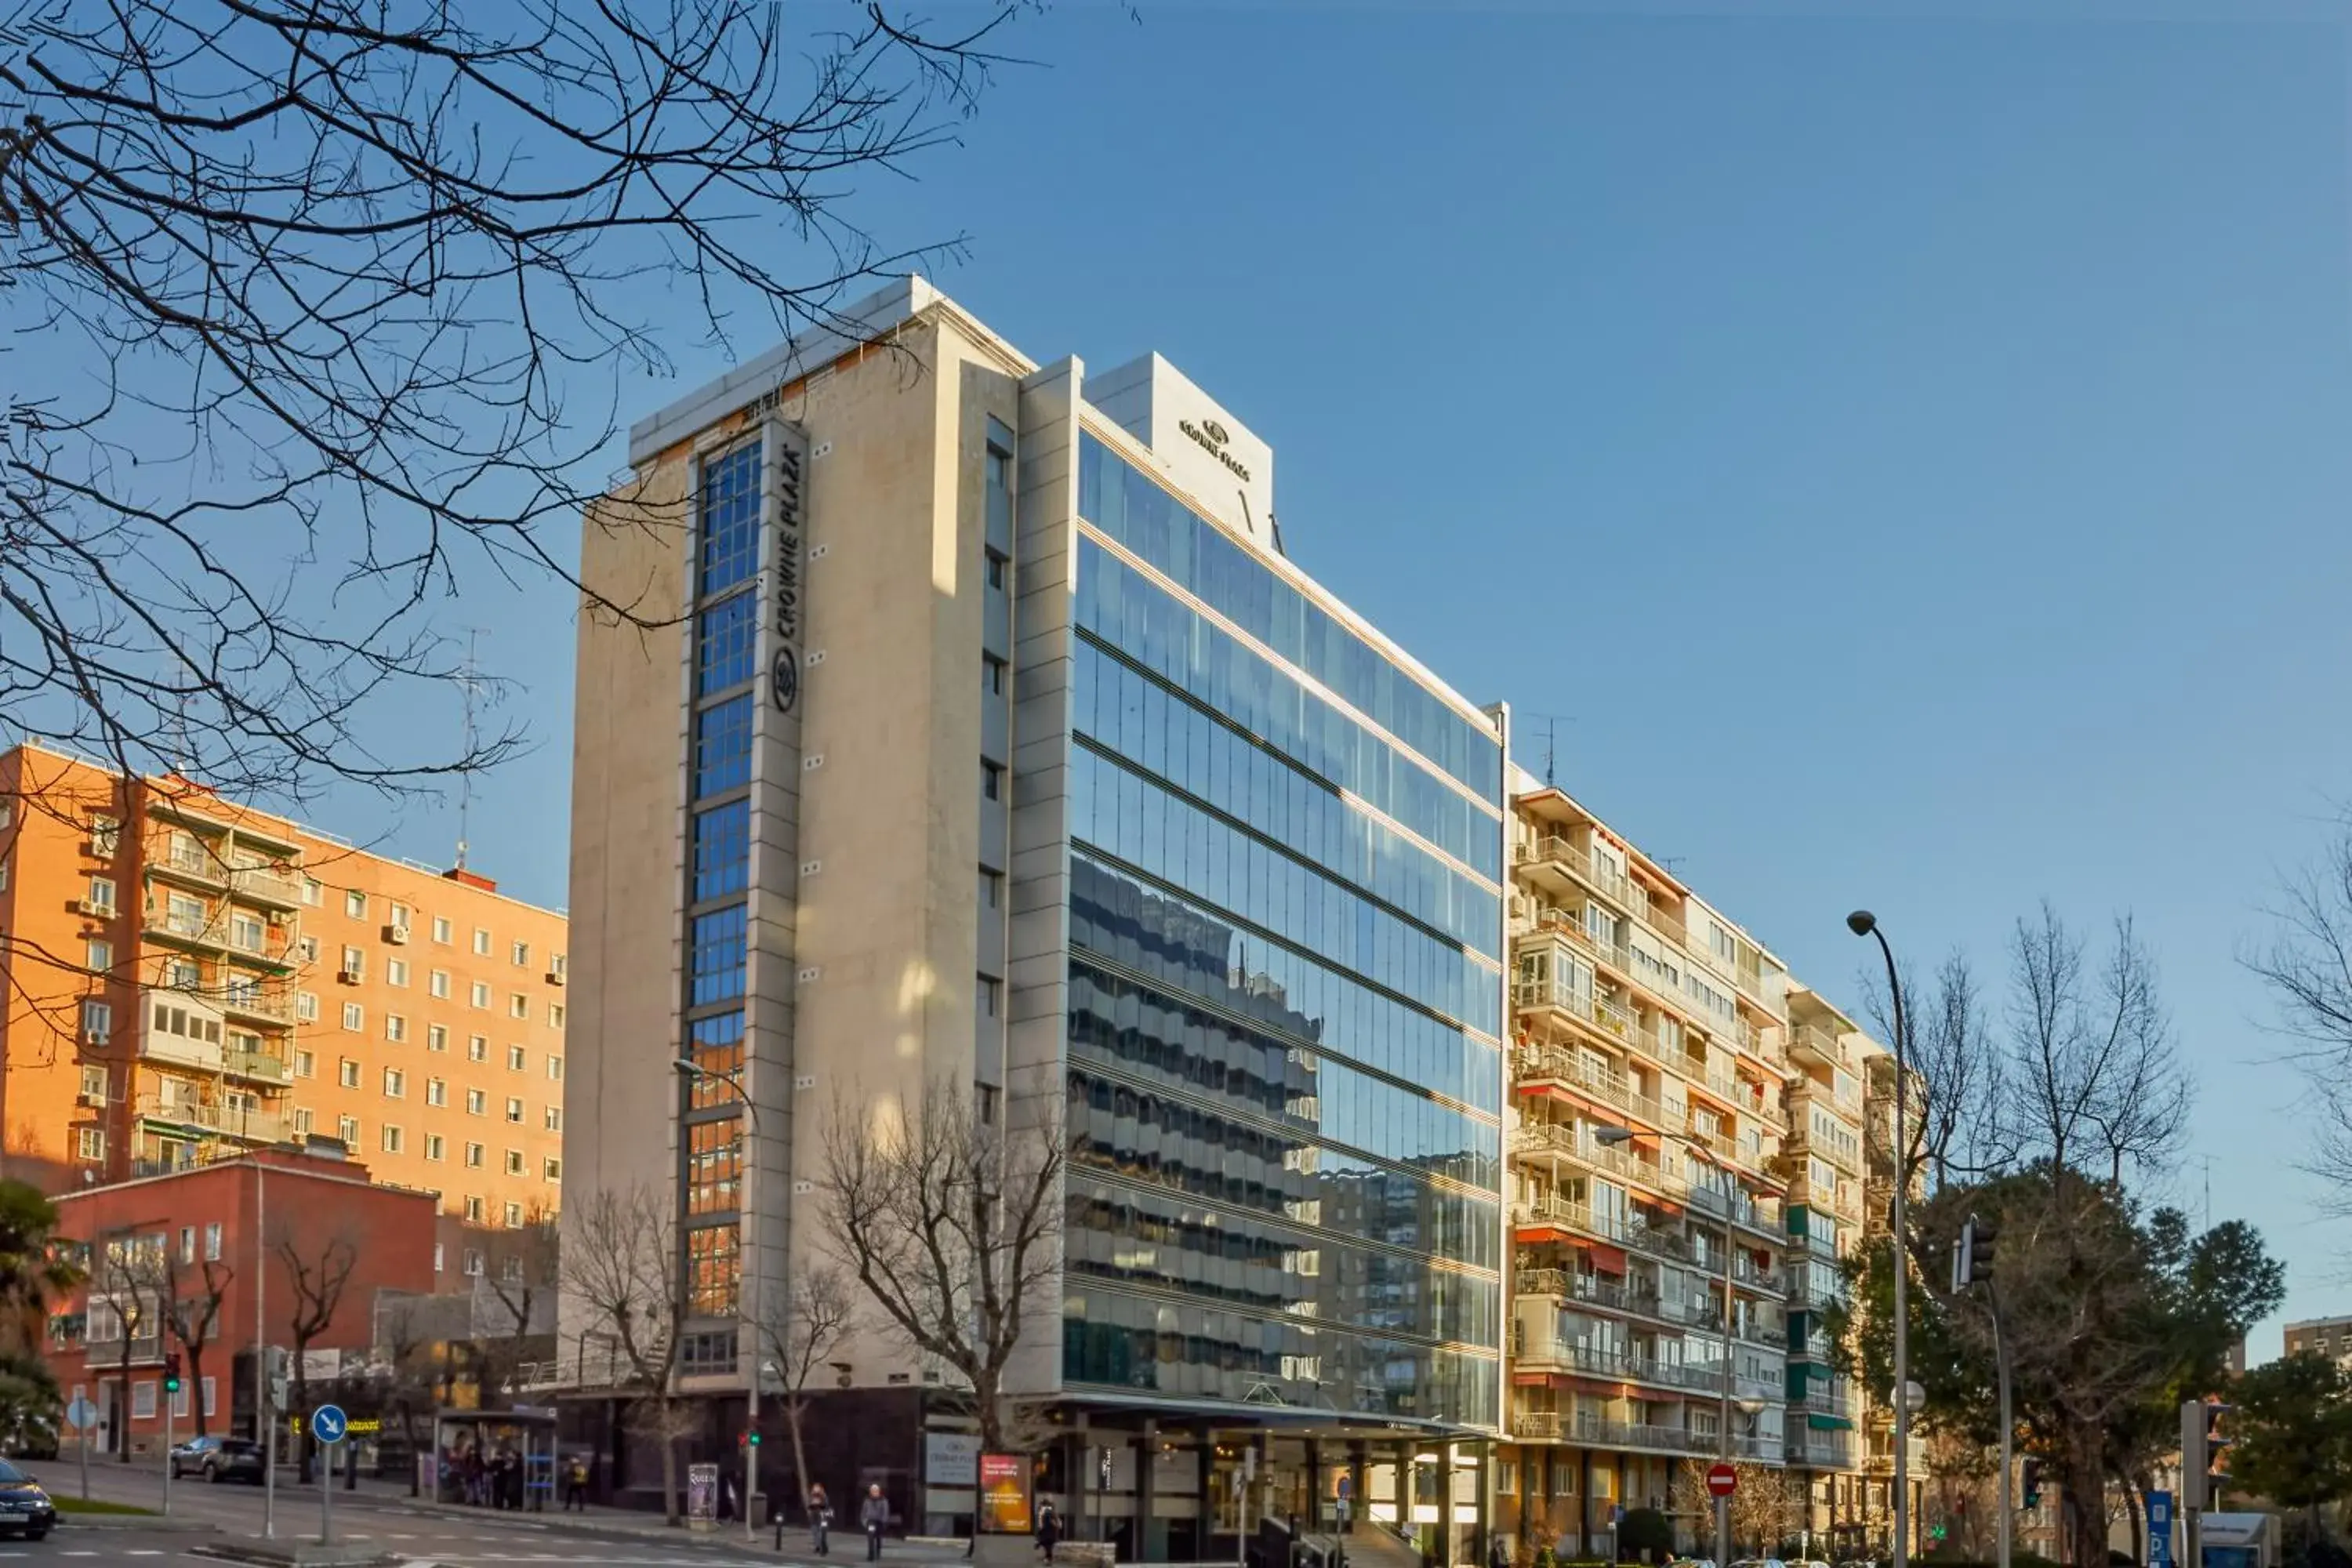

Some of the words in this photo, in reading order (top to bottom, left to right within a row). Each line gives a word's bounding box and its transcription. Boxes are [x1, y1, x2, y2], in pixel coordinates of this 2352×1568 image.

[780, 448, 800, 527] PLAZA
[777, 531, 799, 639] CROWNE
[2151, 1537, 2163, 1556] P
